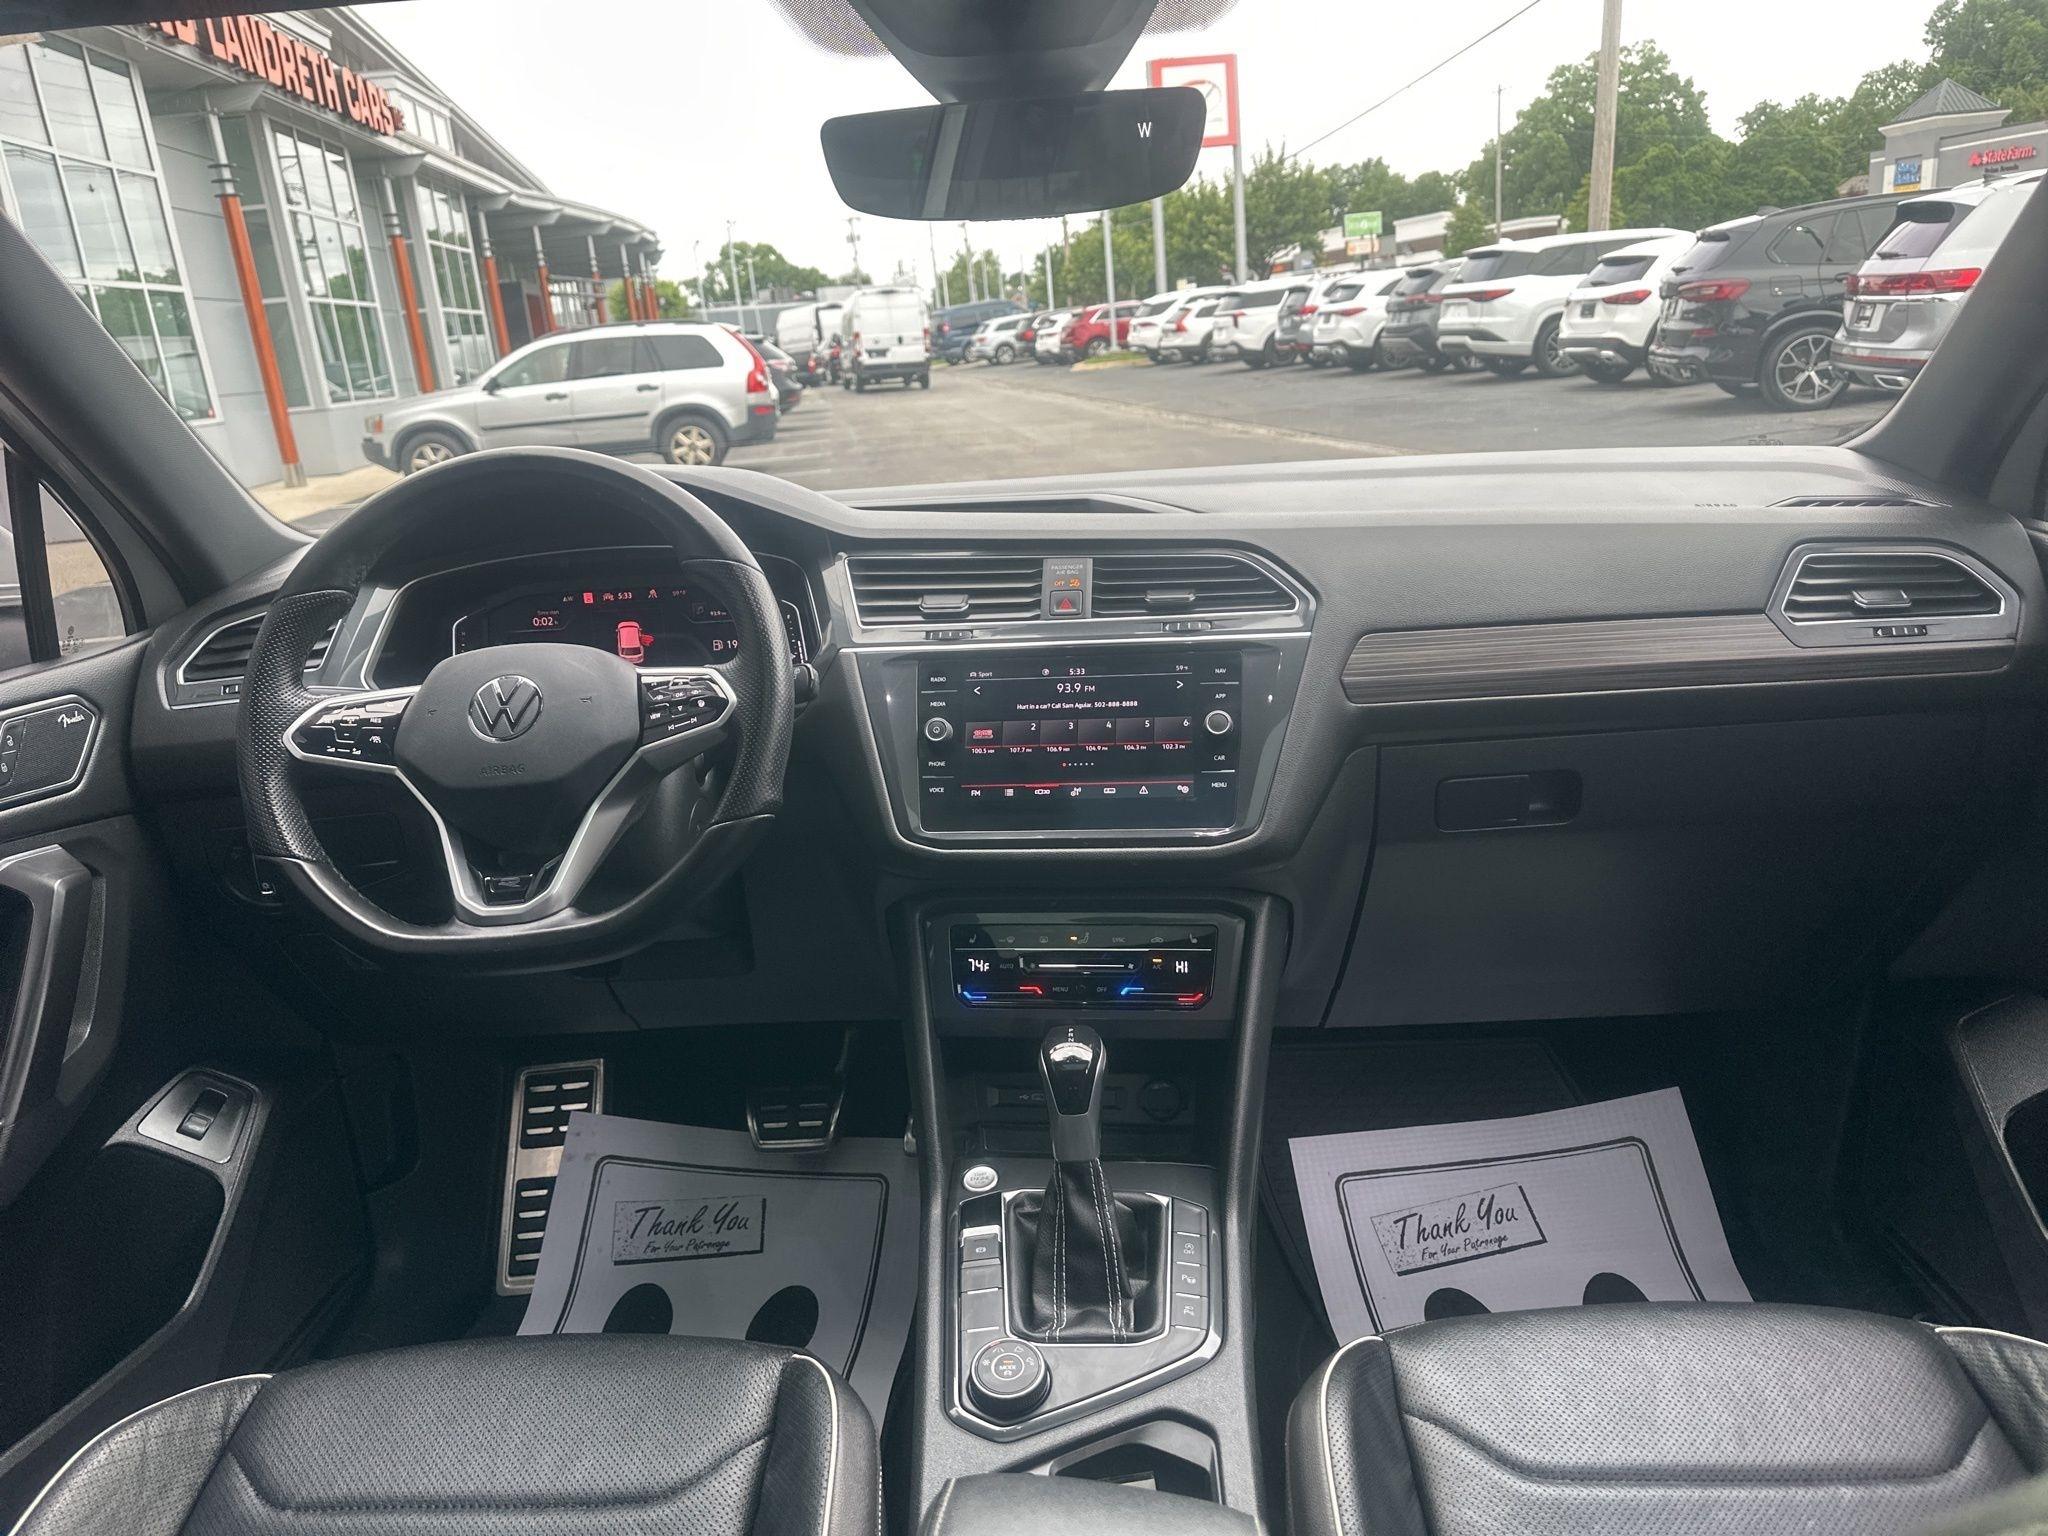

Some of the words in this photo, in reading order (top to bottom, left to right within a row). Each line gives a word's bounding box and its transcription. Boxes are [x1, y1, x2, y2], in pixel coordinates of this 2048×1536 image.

[206, 15, 343, 114] LANDRETH
[341, 64, 395, 136] CARS
[1137, 121, 1152, 138] W
[617, 592, 633, 600] 5:33
[532, 616, 554, 626] 0:02
[726, 640, 738, 649] 19
[1056, 682, 1081, 693] 93.9
[1030, 723, 1036, 731] 2
[1068, 722, 1074, 730] 3
[1144, 720, 1150, 728] 5
[1183, 719, 1189, 727] 6
[1175, 960, 1188, 973] HI
[629, 1204, 708, 1240] Thank
[712, 1201, 750, 1235] You
[1393, 1202, 1471, 1250] Thank
[1476, 1193, 1519, 1231] You
[642, 1241, 661, 1254] For
[664, 1239, 684, 1253] Your
[685, 1237, 731, 1253] Patronage
[1421, 1247, 1438, 1261] For
[1440, 1243, 1461, 1257] Your
[1463, 1233, 1509, 1251] Patronage
